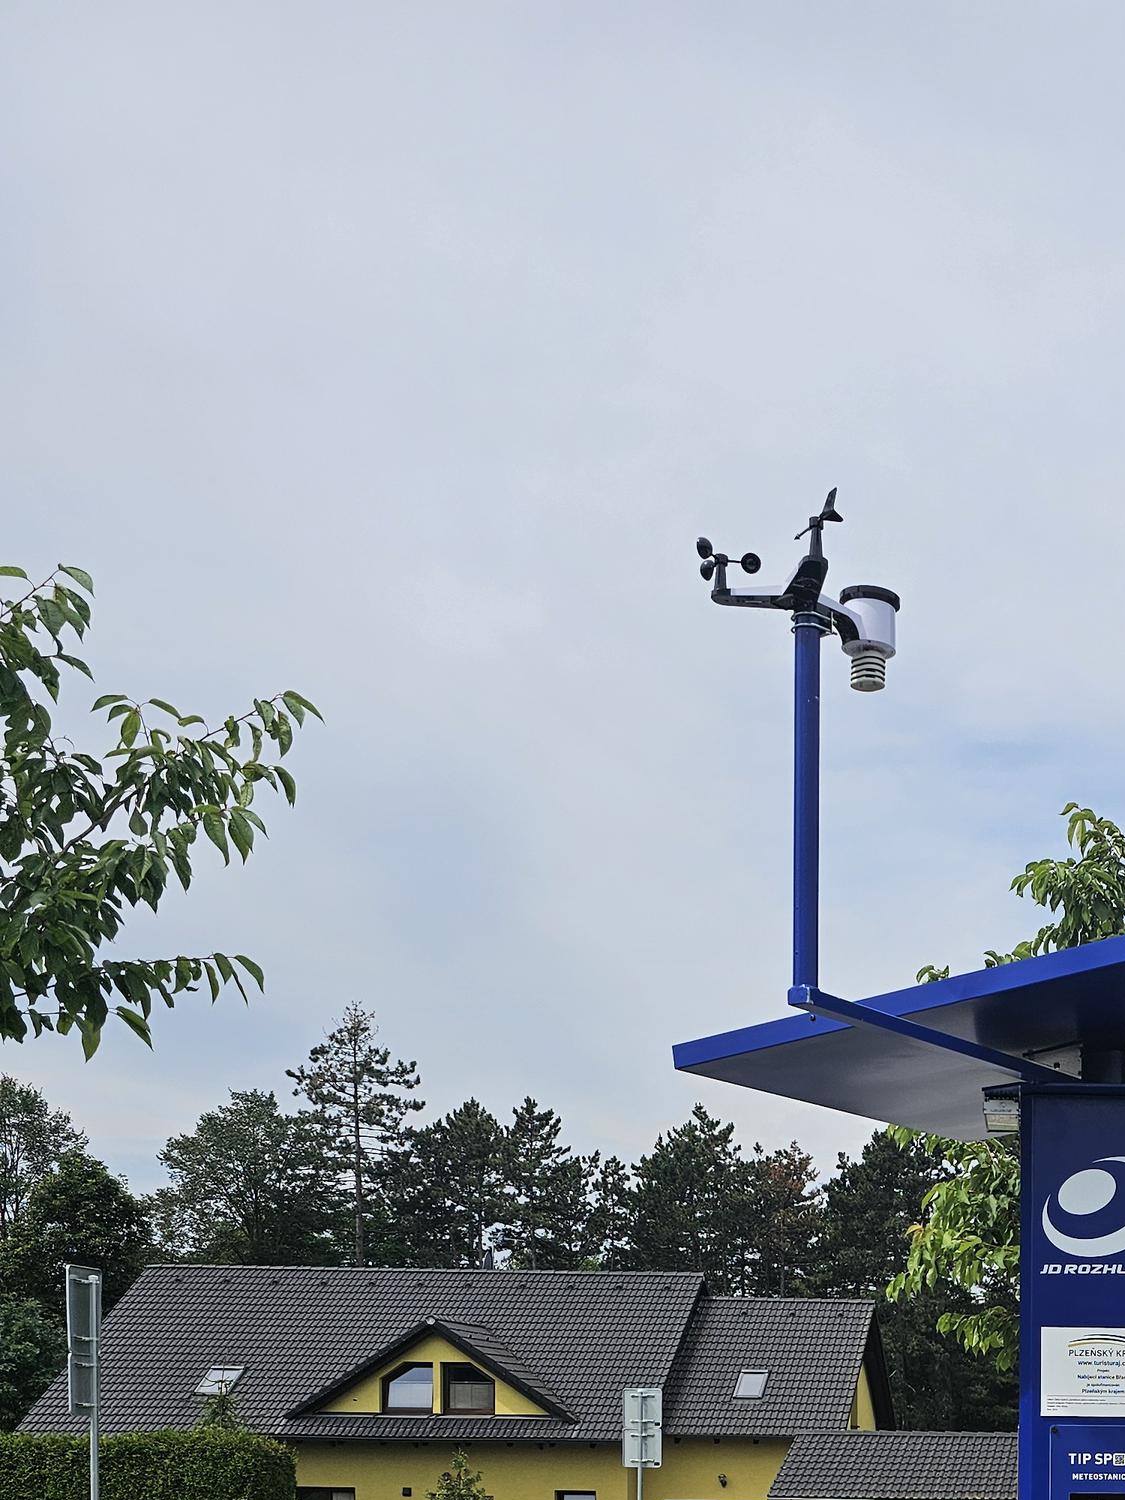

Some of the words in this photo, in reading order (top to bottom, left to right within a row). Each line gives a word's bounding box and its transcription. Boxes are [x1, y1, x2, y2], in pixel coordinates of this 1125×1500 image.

[1039, 1264, 1062, 1275] JD
[1068, 1348, 1114, 1357] PLZEŇSKÝ
[1068, 1453, 1091, 1465] TIP
